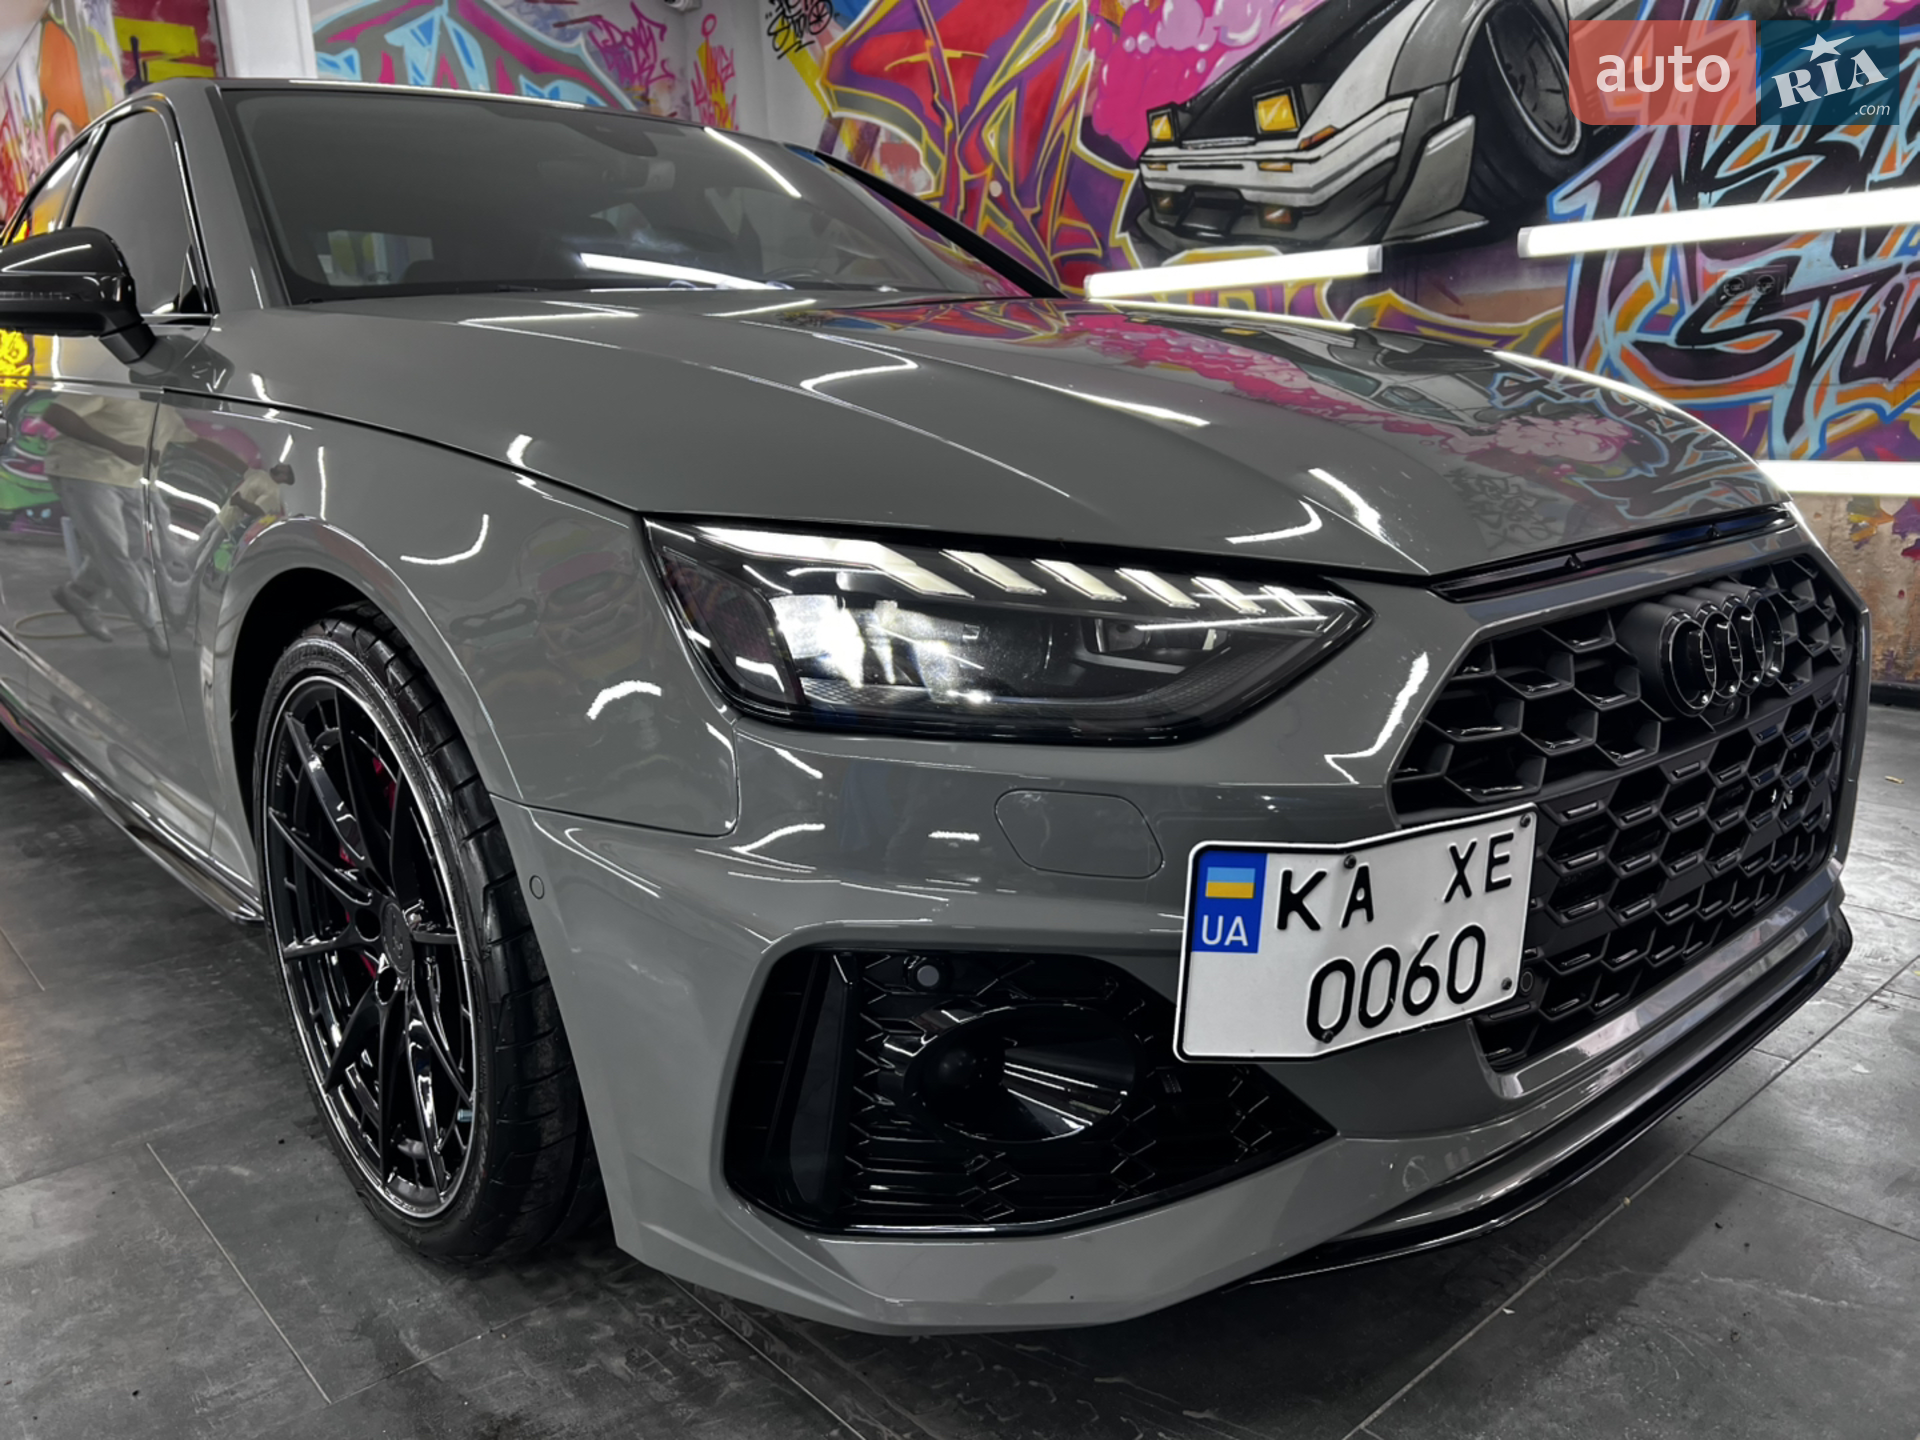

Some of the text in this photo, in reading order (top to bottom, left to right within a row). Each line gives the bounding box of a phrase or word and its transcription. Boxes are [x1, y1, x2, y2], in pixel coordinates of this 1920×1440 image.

[1201, 914, 1249, 947] UA
[1276, 832, 1515, 931] KA XE
[1305, 924, 1486, 1041] 0060
